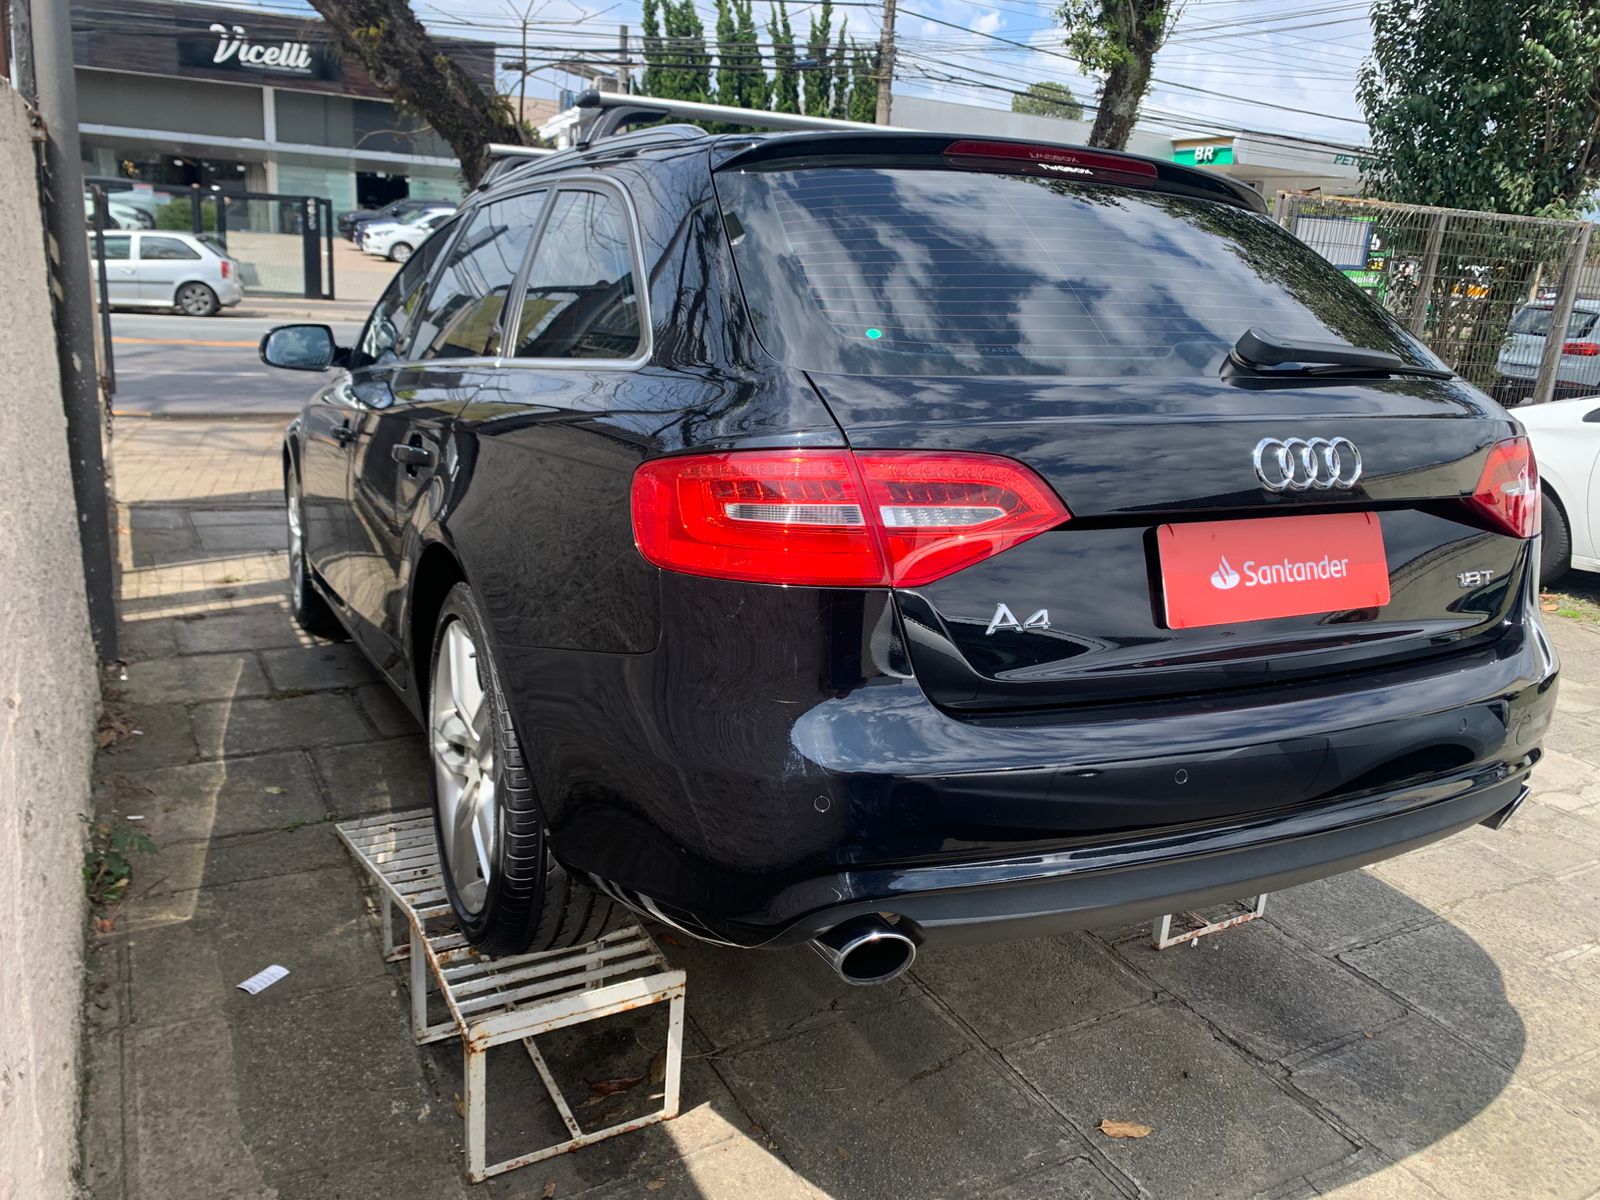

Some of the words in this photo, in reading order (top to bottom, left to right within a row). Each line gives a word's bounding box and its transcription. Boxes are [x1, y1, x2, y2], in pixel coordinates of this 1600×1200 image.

[209, 23, 312, 69] Vicelli
[1194, 147, 1214, 161] BR
[1243, 554, 1348, 587] Santander
[985, 602, 1051, 636] A4
